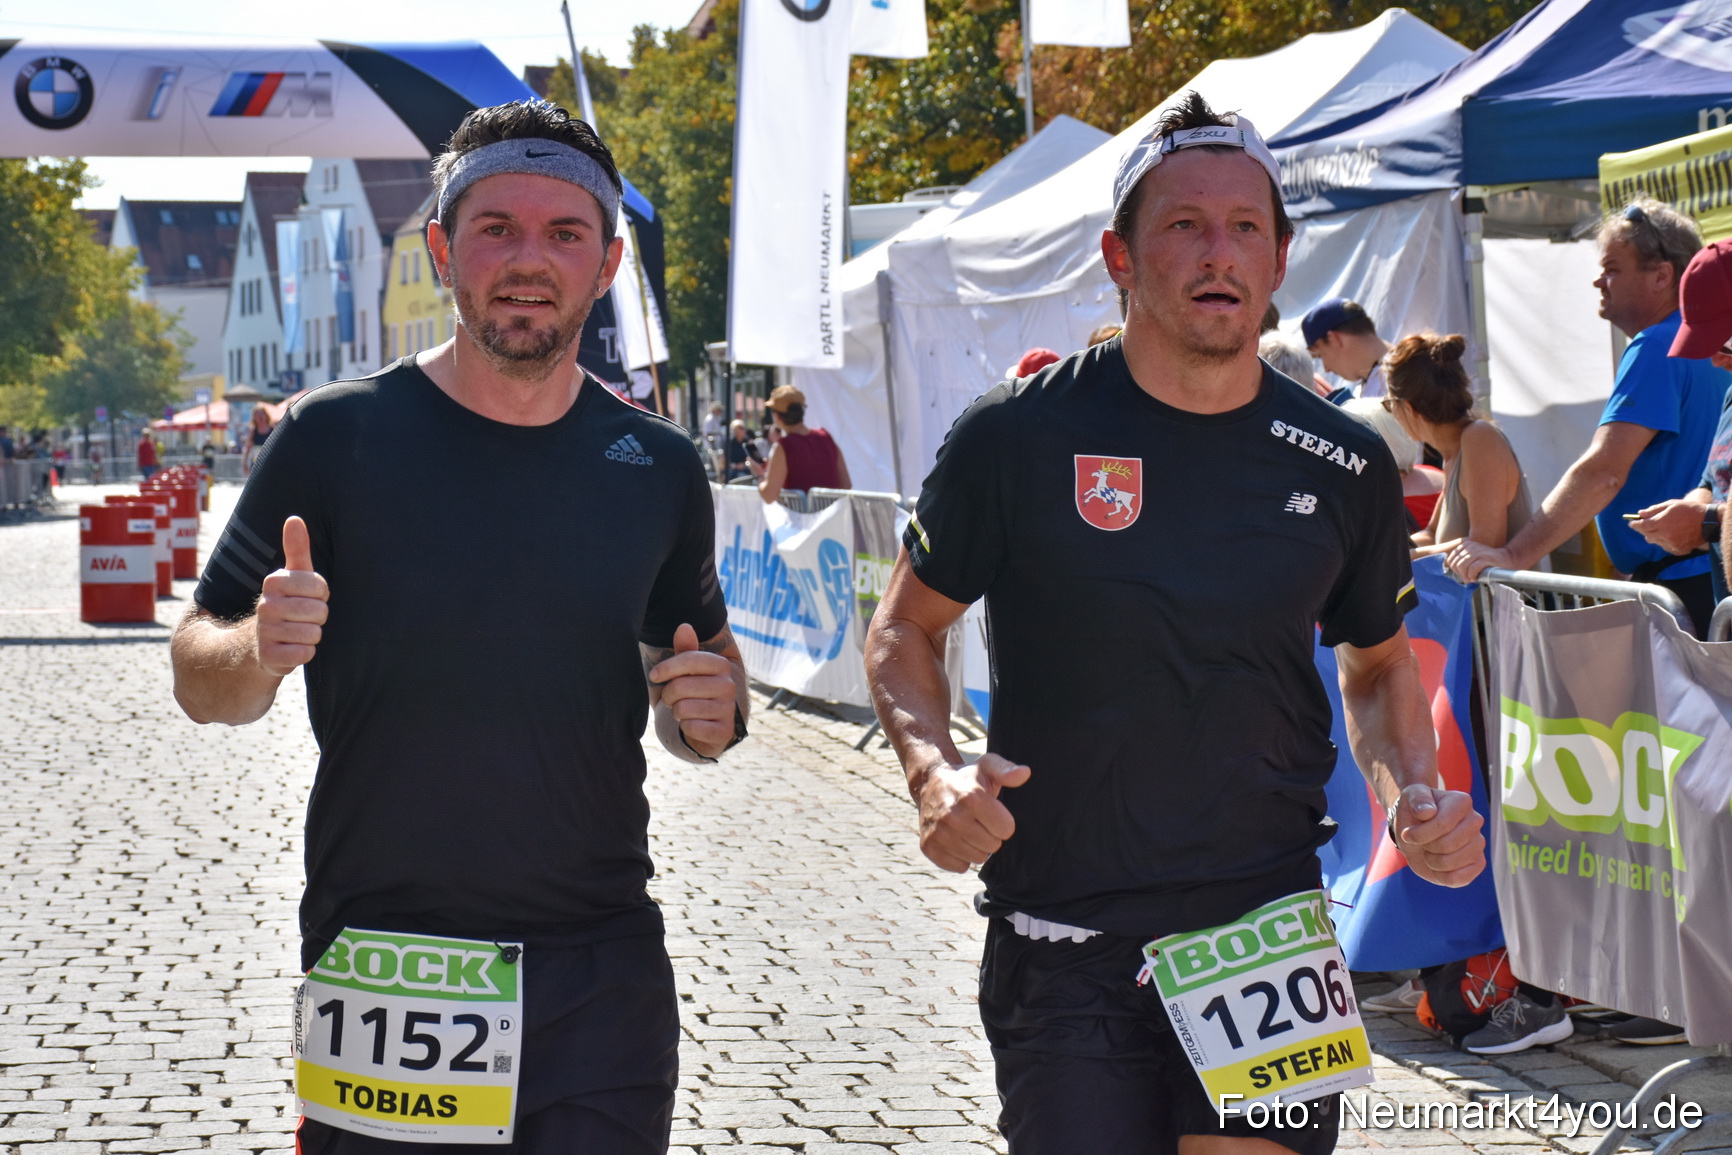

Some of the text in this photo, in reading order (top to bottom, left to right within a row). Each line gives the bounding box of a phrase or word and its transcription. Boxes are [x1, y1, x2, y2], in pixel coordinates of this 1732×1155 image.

[22, 57, 86, 79] BMW
[820, 192, 835, 356] PARTL NEUMARKT
[605, 450, 654, 466] adidas
[1270, 420, 1368, 476] STEFAN
[90, 555, 127, 571] AVIA
[316, 940, 490, 989] BOCK
[1171, 902, 1330, 980] BOCK
[500, 1019, 510, 1030] D
[1200, 959, 1348, 1050] 1206
[317, 998, 490, 1073] 1152
[1248, 1039, 1355, 1089] STEFAN
[334, 1079, 458, 1118] TOBIAS
